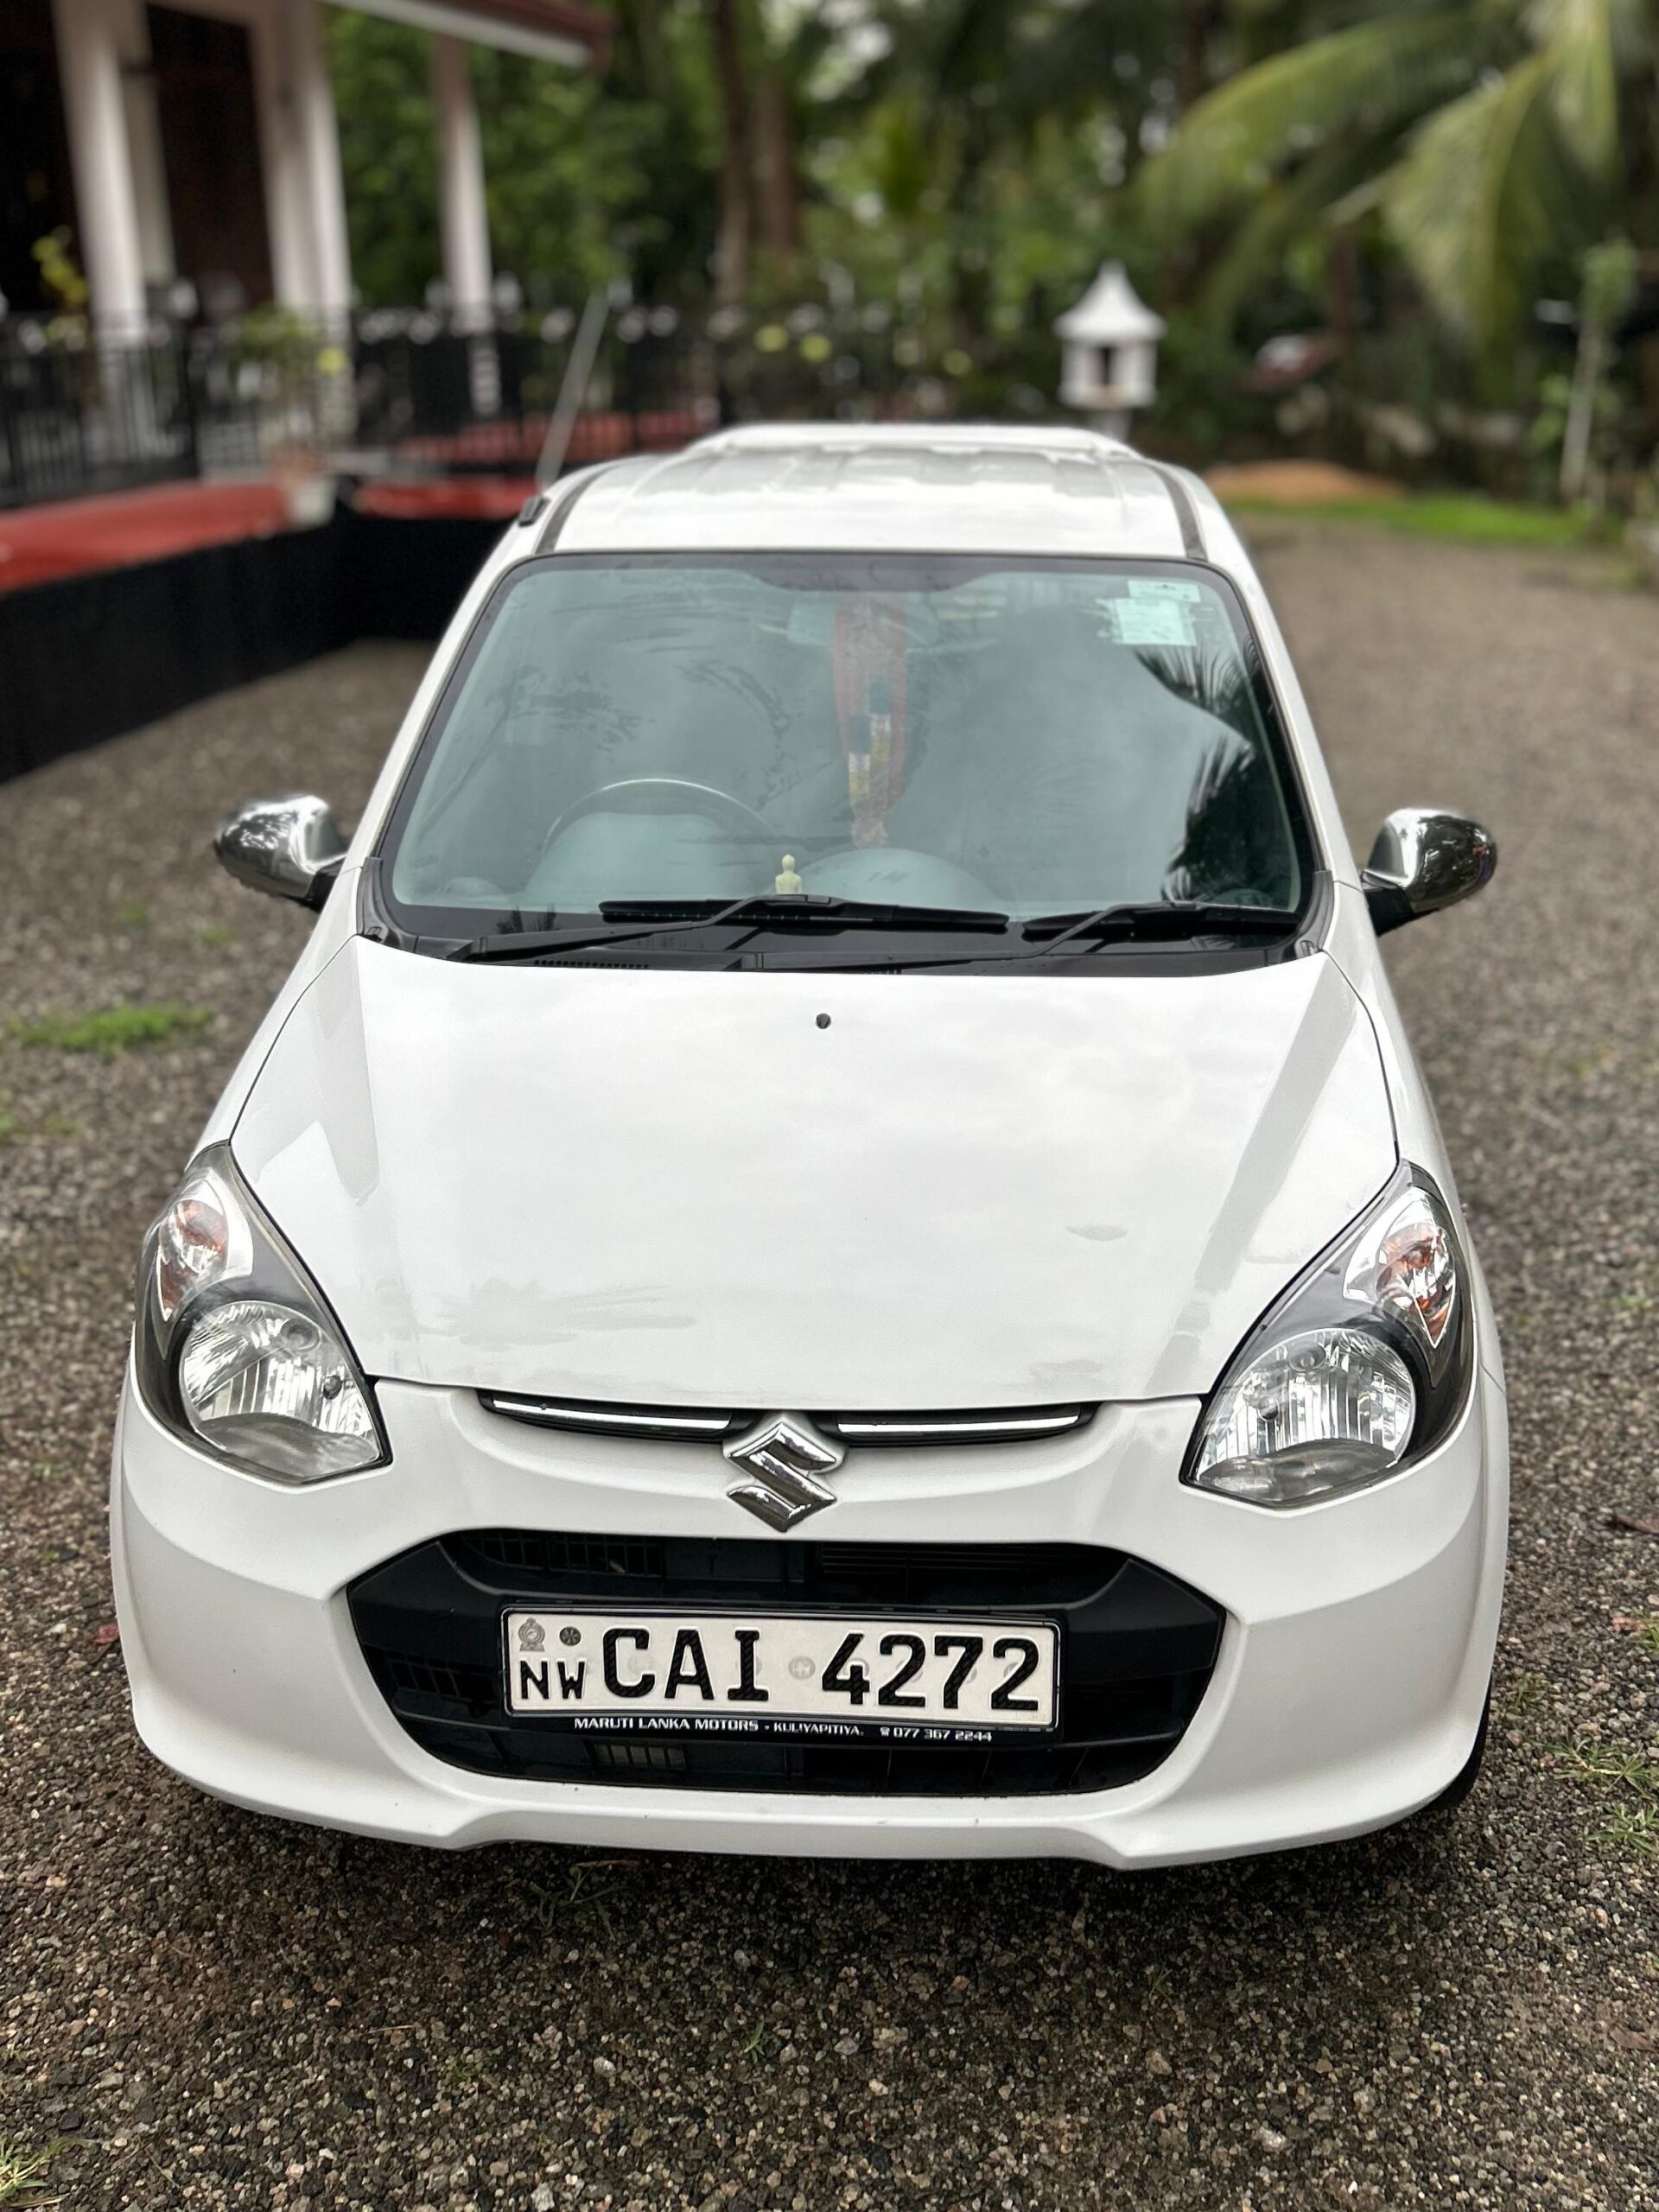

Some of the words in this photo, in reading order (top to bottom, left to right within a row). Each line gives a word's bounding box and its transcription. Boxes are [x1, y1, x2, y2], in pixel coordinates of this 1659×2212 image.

[520, 1660, 586, 1700] NW
[603, 1628, 769, 1701] CAI
[823, 1633, 1039, 1710] 4272
[575, 1718, 633, 1729] MARUTI
[639, 1718, 690, 1729] LANKA
[695, 1719, 759, 1732] MOTORS
[893, 1726, 919, 1738] 077
[924, 1729, 950, 1739] 367
[955, 1731, 992, 1742] 2244
